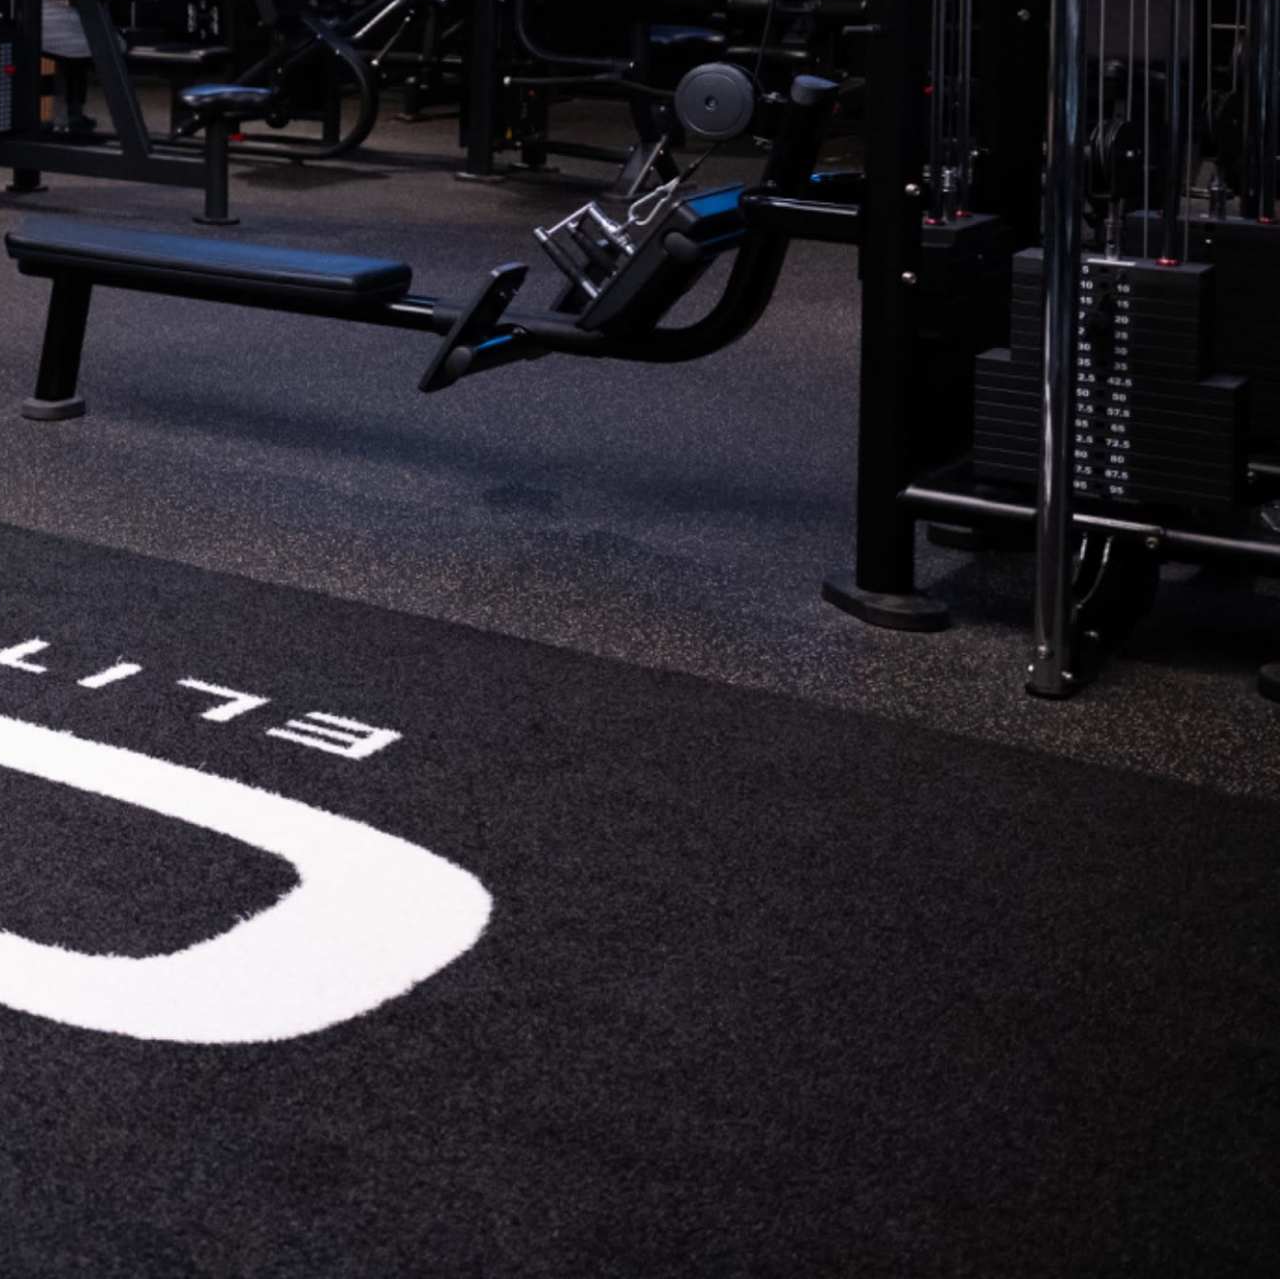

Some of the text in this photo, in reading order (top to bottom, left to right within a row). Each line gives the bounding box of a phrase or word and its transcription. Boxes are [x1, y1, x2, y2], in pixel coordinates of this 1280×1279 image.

[1080, 280, 1094, 290] 10
[1080, 296, 1093, 305] 15
[1114, 315, 1129, 325] 20
[1078, 342, 1092, 352] 30
[1077, 357, 1091, 367] 35
[1076, 388, 1090, 397] 50
[1106, 407, 1130, 418] 57.5
[1105, 438, 1131, 449] 72.5
[1110, 455, 1125, 464] 80
[1104, 469, 1129, 480] 87.5
